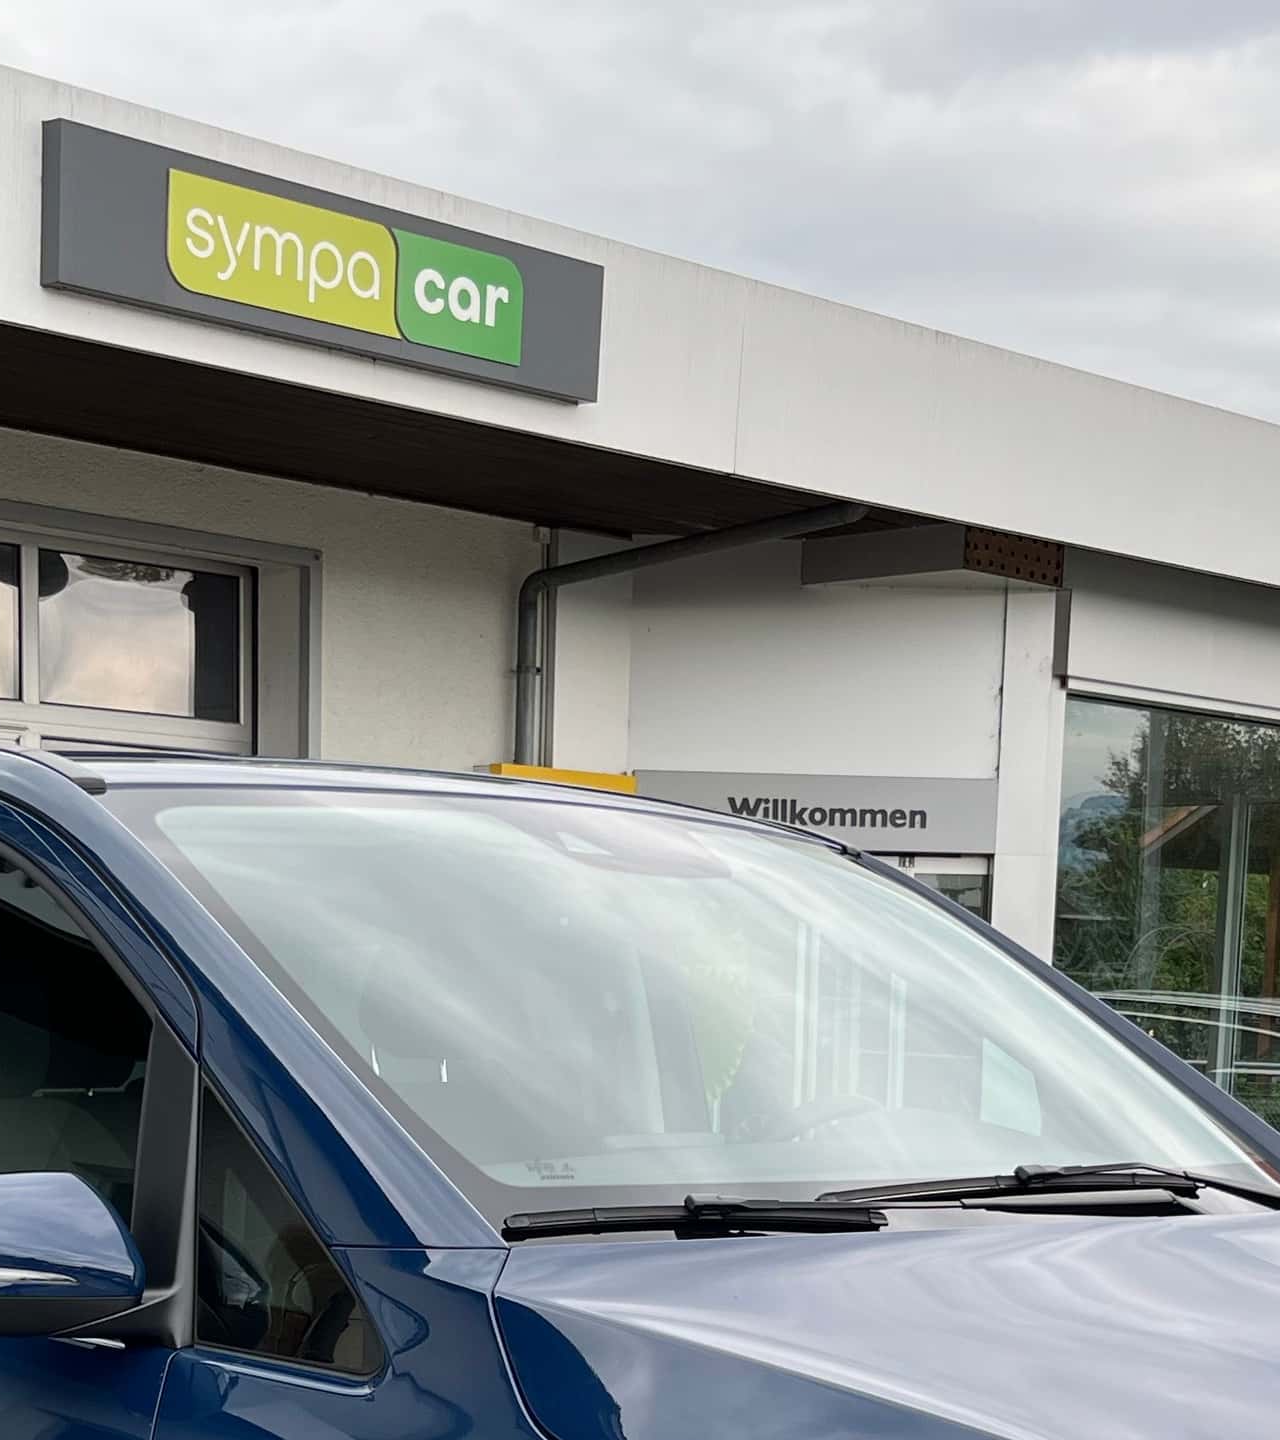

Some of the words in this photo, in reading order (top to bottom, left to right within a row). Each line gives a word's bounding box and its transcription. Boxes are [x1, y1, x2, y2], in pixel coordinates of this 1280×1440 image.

[184, 206, 381, 303] sympa
[413, 267, 510, 327] car
[727, 796, 927, 829] Willkommen
